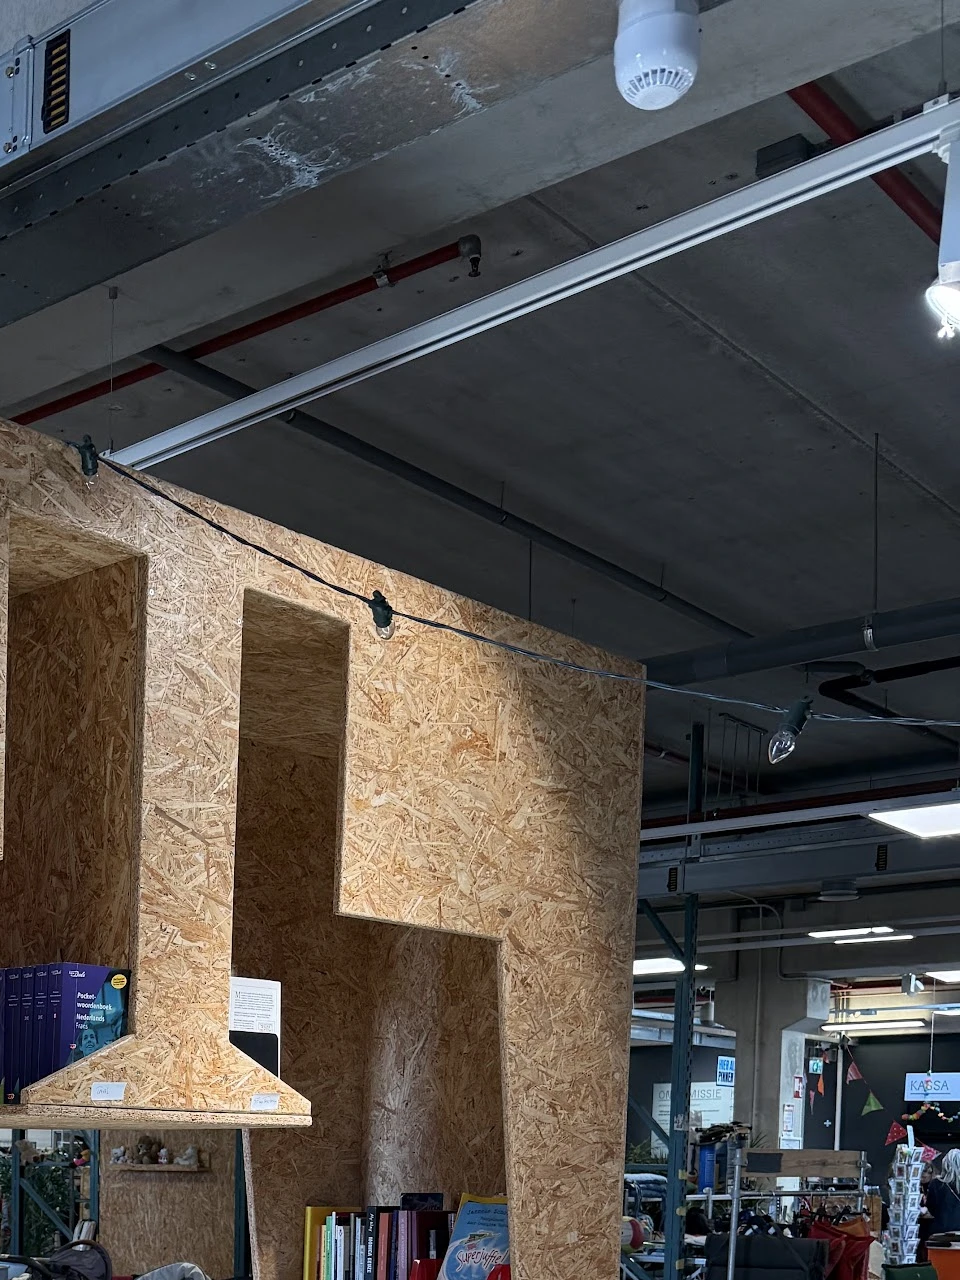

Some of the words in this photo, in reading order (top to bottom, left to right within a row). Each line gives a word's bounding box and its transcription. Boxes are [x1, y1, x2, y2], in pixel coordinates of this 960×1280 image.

[77, 1002, 113, 1010] woordenboek
[76, 1013, 105, 1022] Nederlands
[76, 1022, 88, 1030] Frans
[910, 1080, 949, 1091] KASSA
